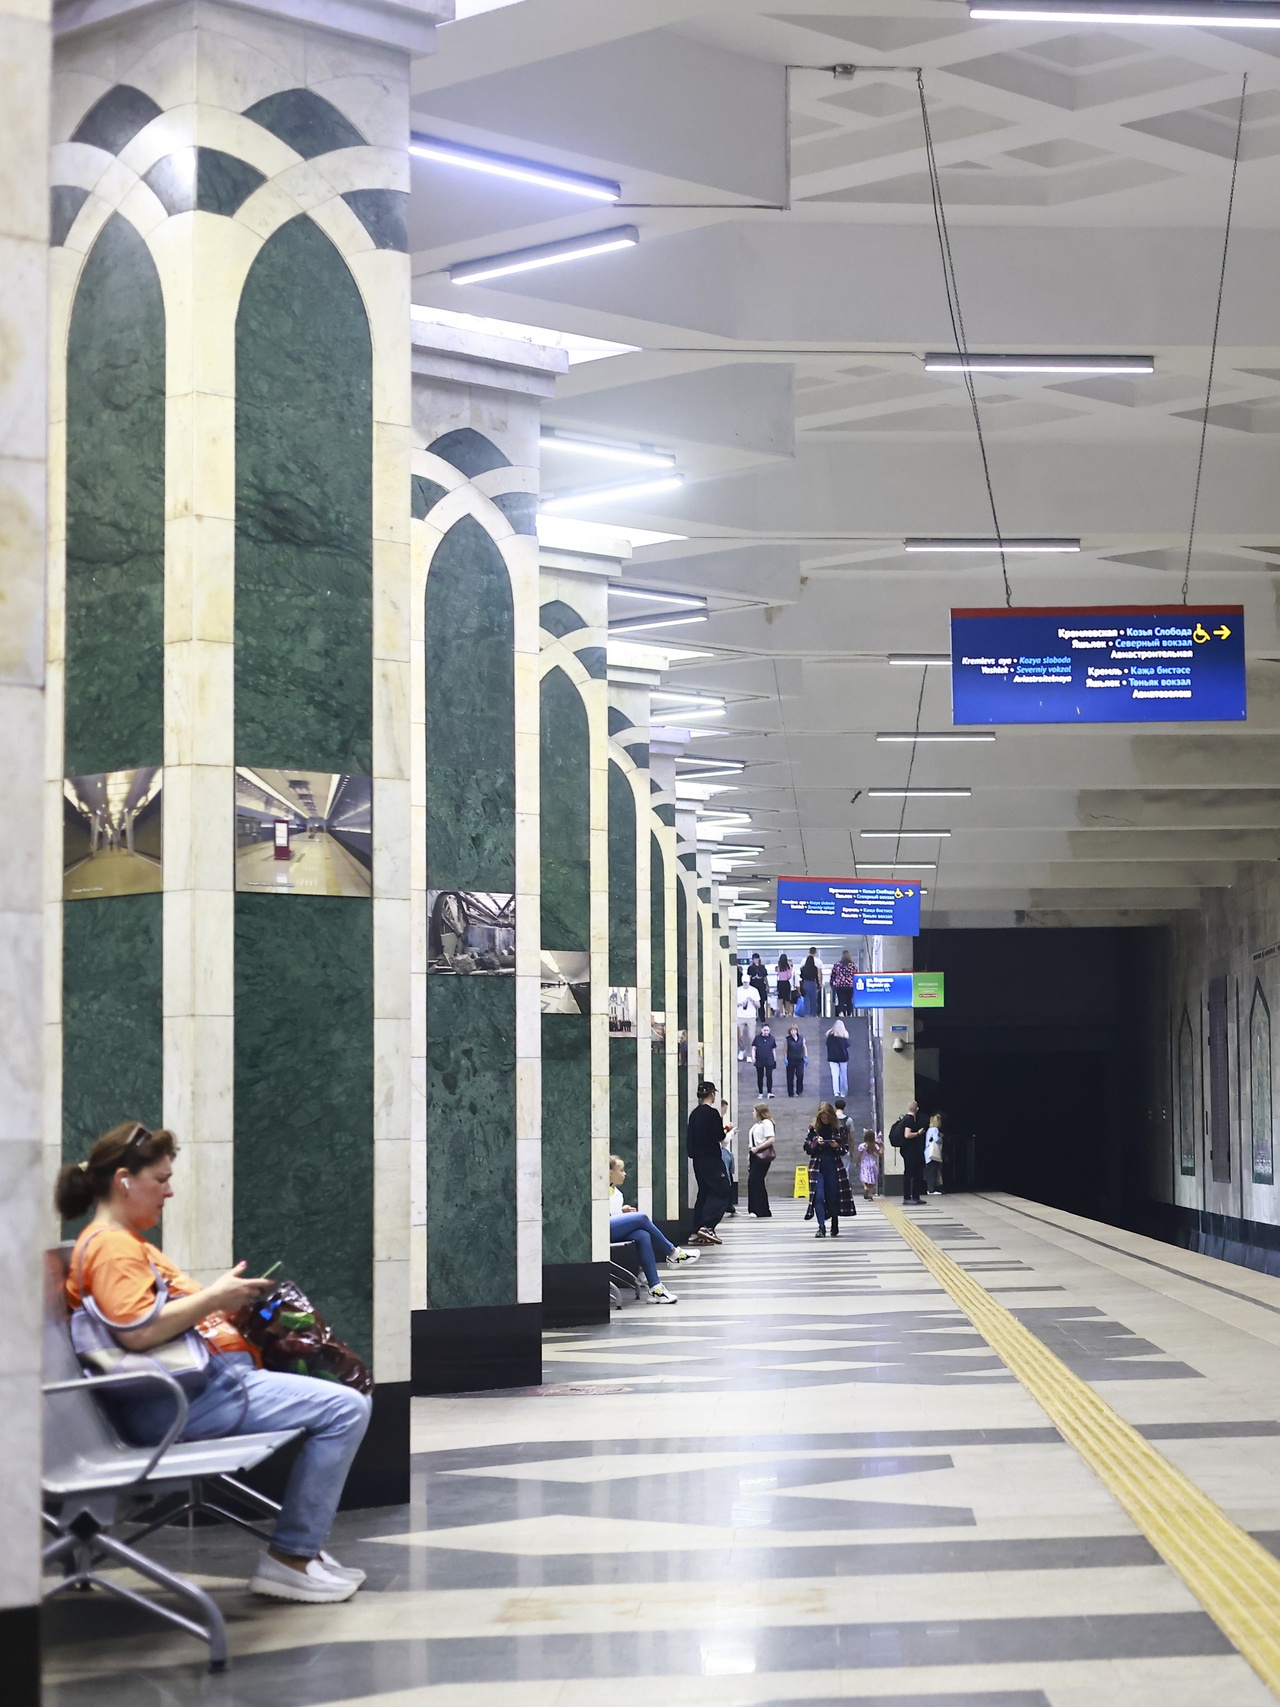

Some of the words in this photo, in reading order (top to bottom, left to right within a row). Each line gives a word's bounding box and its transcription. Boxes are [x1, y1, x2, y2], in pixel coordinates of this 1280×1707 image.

[1126, 627, 1152, 637] Козья
[1154, 627, 1192, 637] Слобода
[1115, 639, 1160, 649] Северный
[1162, 639, 1193, 647] вокзал
[1110, 649, 1193, 660] Авиастроительная
[1043, 656, 1072, 665] sloboda
[1016, 665, 1047, 675] Severniy
[1048, 665, 1072, 673] vokzal
[1160, 678, 1191, 686] вокзал
